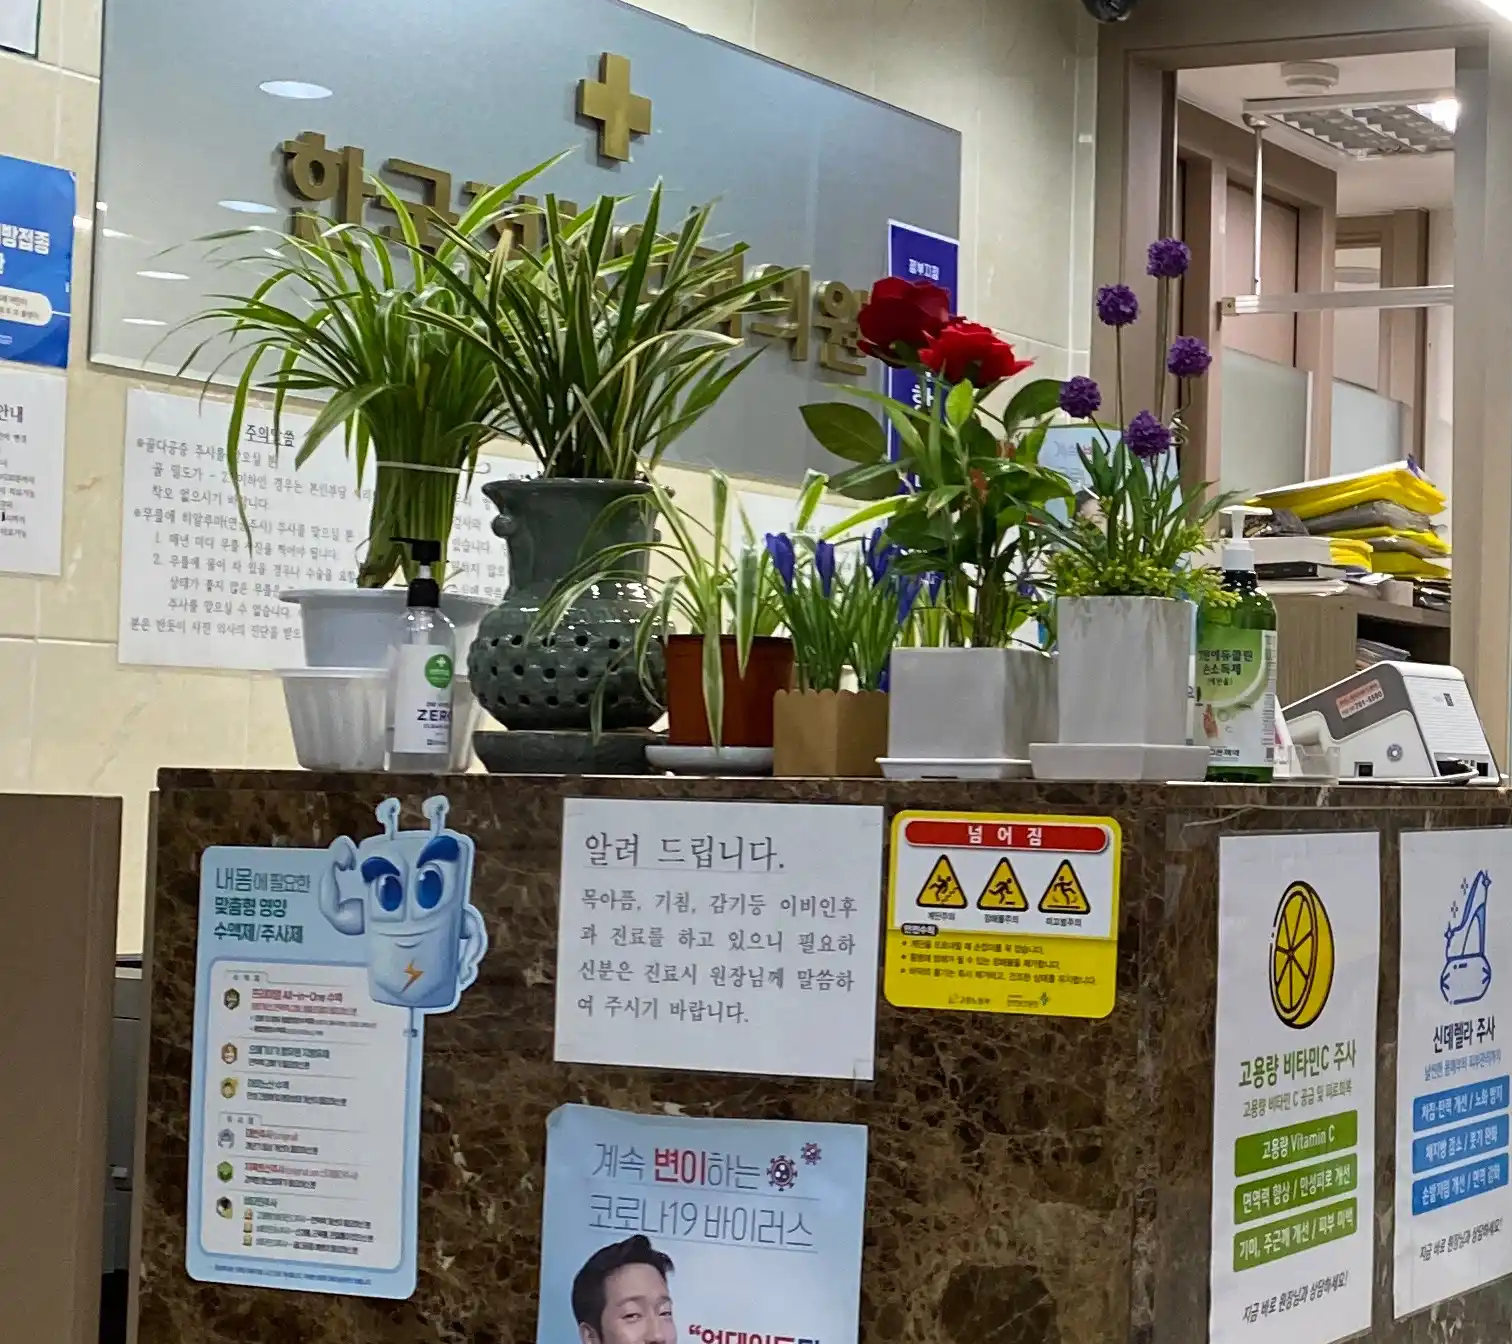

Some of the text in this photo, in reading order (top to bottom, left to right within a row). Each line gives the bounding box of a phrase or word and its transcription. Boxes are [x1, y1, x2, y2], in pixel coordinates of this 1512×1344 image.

[0, 223, 50, 255] 방접종
[233, 449, 261, 467] 으실
[1203, 663, 1241, 676] 손소독제
[584, 832, 785, 871] 알려 드립니다.
[967, 824, 1043, 847] 넘어짐
[214, 895, 287, 918] 맞춤형 영양
[580, 887, 858, 920] 목아픔, 기침, 감기등 이비인후
[213, 921, 303, 944] 수액제/주사제
[580, 924, 857, 956] 과 진료를 하고 있으니 필요하
[579, 959, 856, 993] 신분은 진료시 원장님께 말씀하
[577, 996, 749, 1026] 여 주시기 바랍니다.
[1432, 1015, 1496, 1053] 신데렐라 주사
[1238, 1038, 1357, 1089] 고용량 비타민C 주사
[1242, 1098, 1267, 1120] 고용량
[1262, 1124, 1336, 1160] 고용량 Vitamin C
[591, 1142, 763, 1191] 계속 변이하는
[1242, 1163, 1352, 1215] 면역력 향상 만성피로 개선
[587, 1195, 815, 1249] 코로나19 바이러스
[1239, 1236, 1261, 1262] 기미,
[1292, 1221, 1310, 1246] 개선
[1318, 1214, 1335, 1237] 피부
[1242, 1302, 1260, 1325] 지금
[1260, 1295, 1277, 1318] 바로
